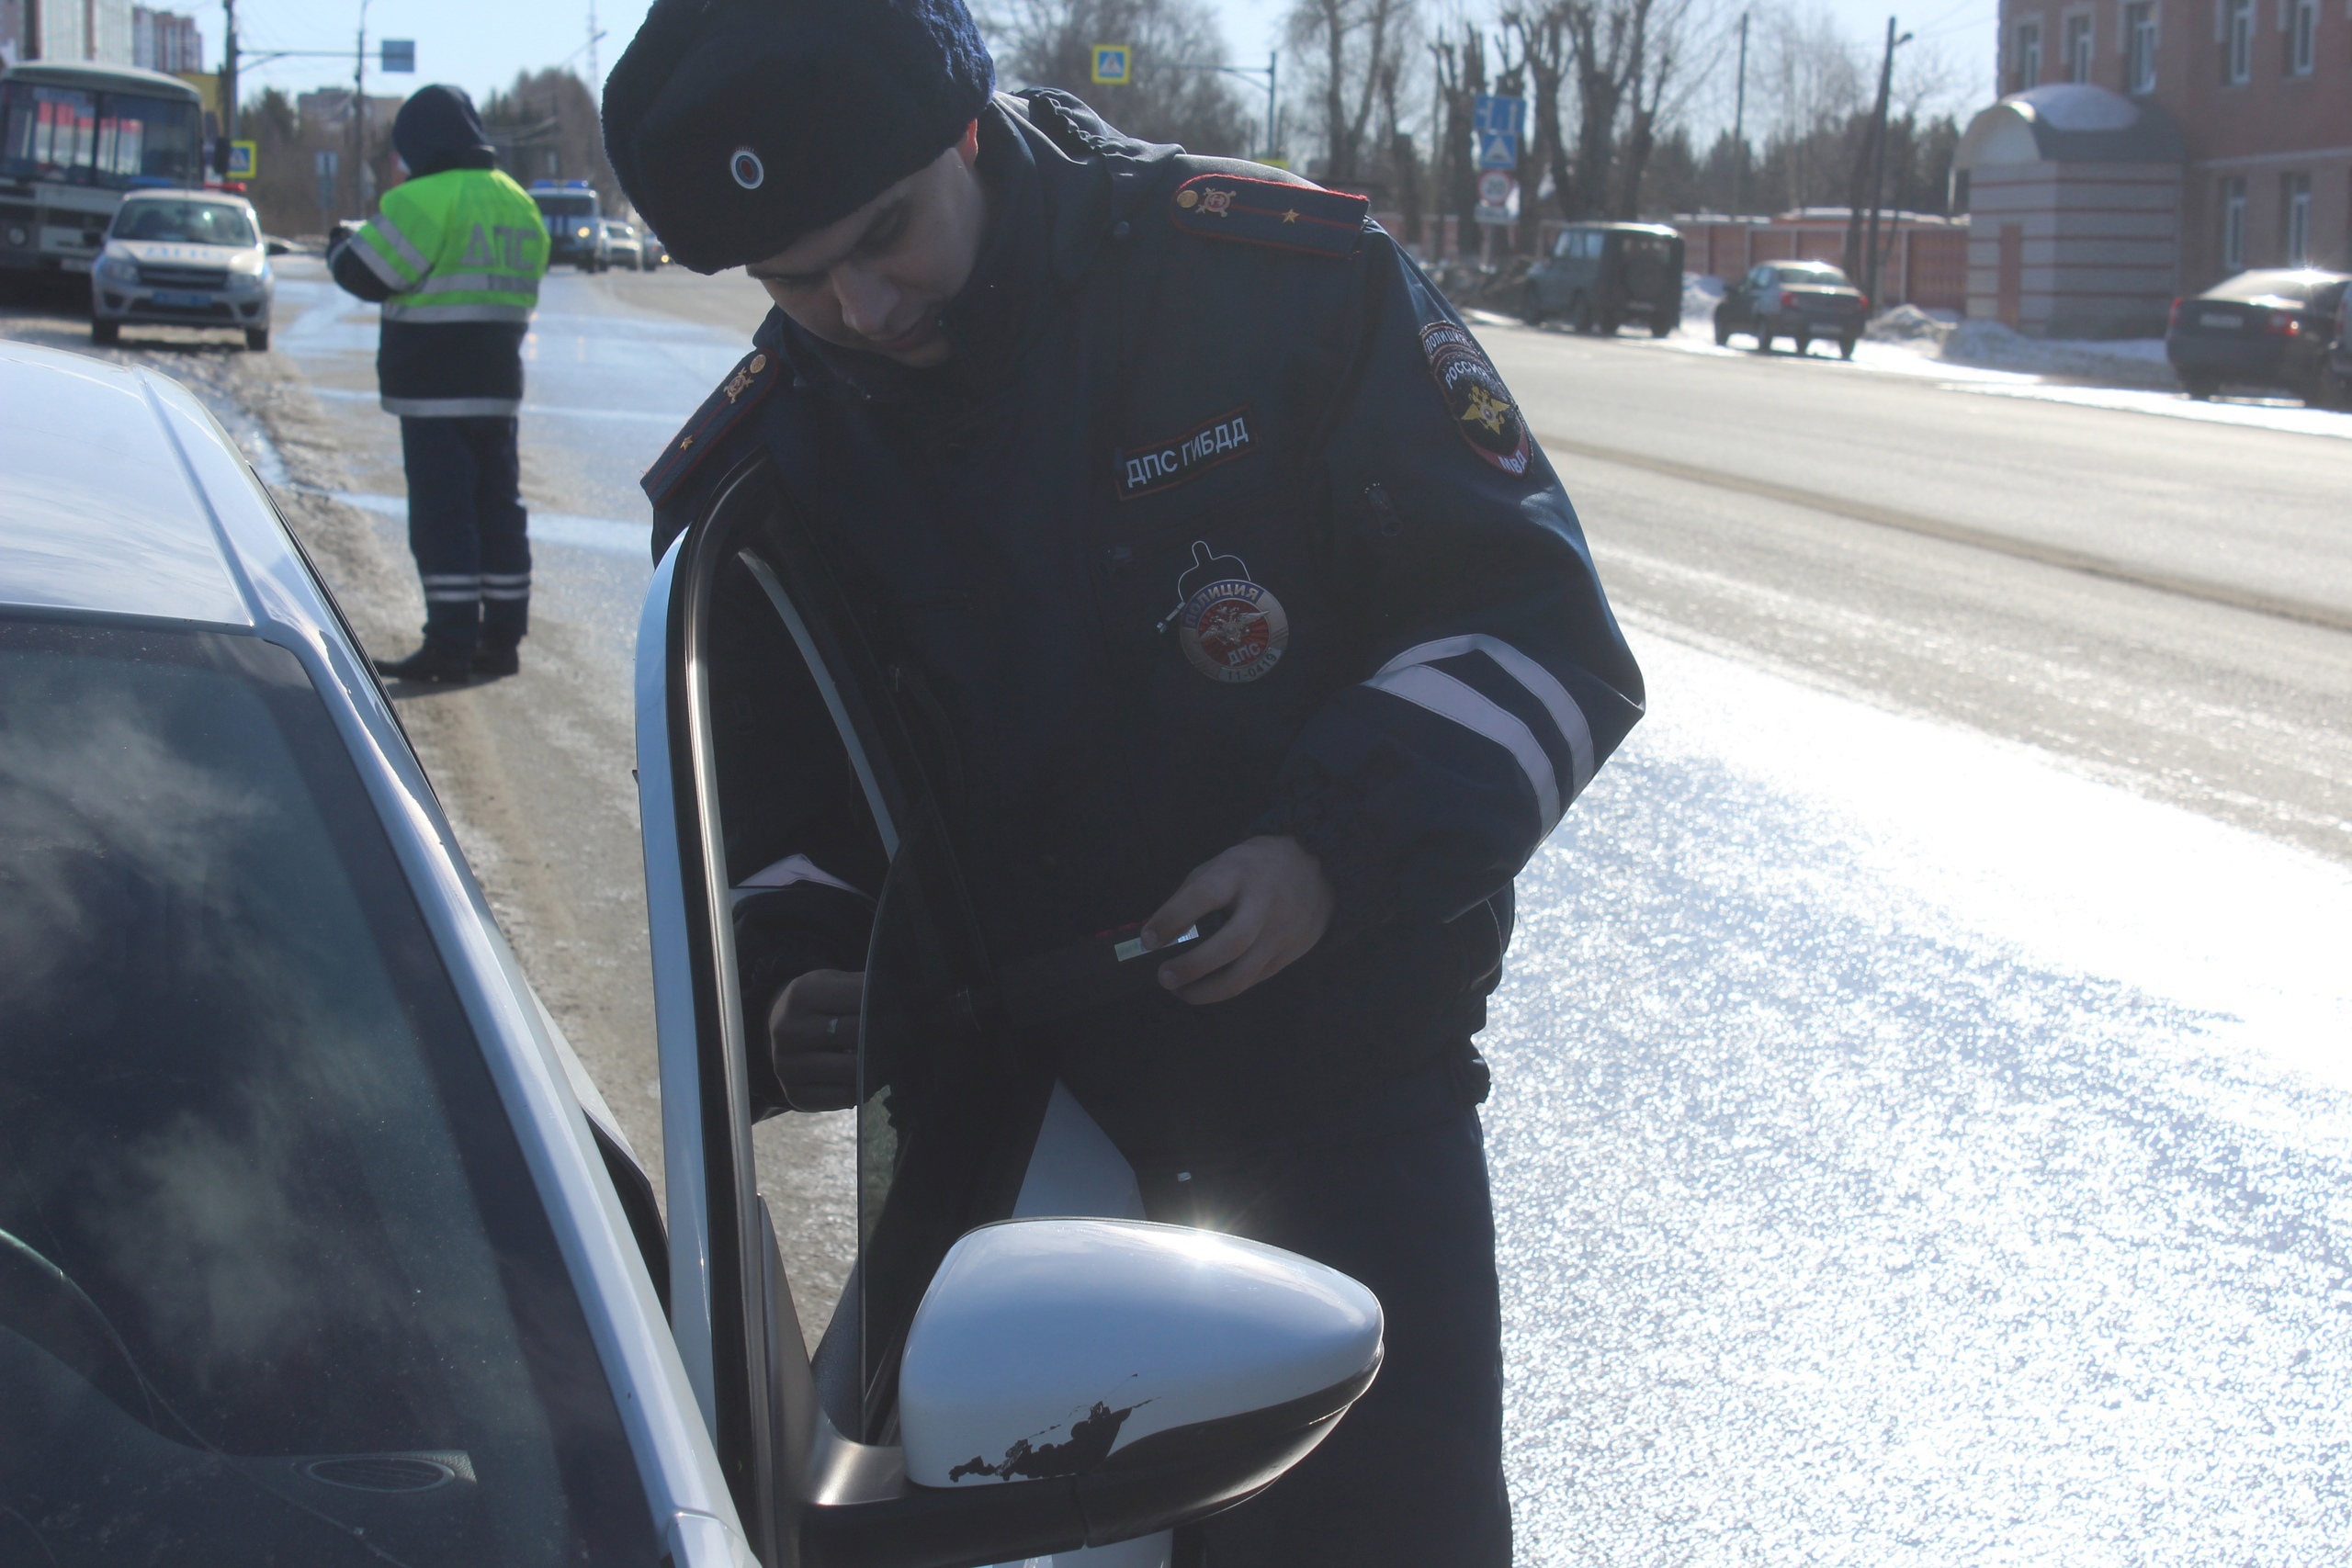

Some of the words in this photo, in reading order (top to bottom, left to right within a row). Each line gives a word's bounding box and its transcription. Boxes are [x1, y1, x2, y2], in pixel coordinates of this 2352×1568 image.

[460, 222, 537, 271] ДПС
[1425, 330, 1470, 354] ПОЛИЦИЯ
[1445, 361, 1490, 390] РОССИЯ
[1125, 450, 1178, 489] ДПС
[1181, 416, 1250, 467] ГИБДД
[1498, 449, 1528, 474] МВД
[1185, 583, 1260, 626] ПОЛИЦИЯ
[1227, 643, 1261, 666] ДПС
[1227, 651, 1278, 682] 11-0419
